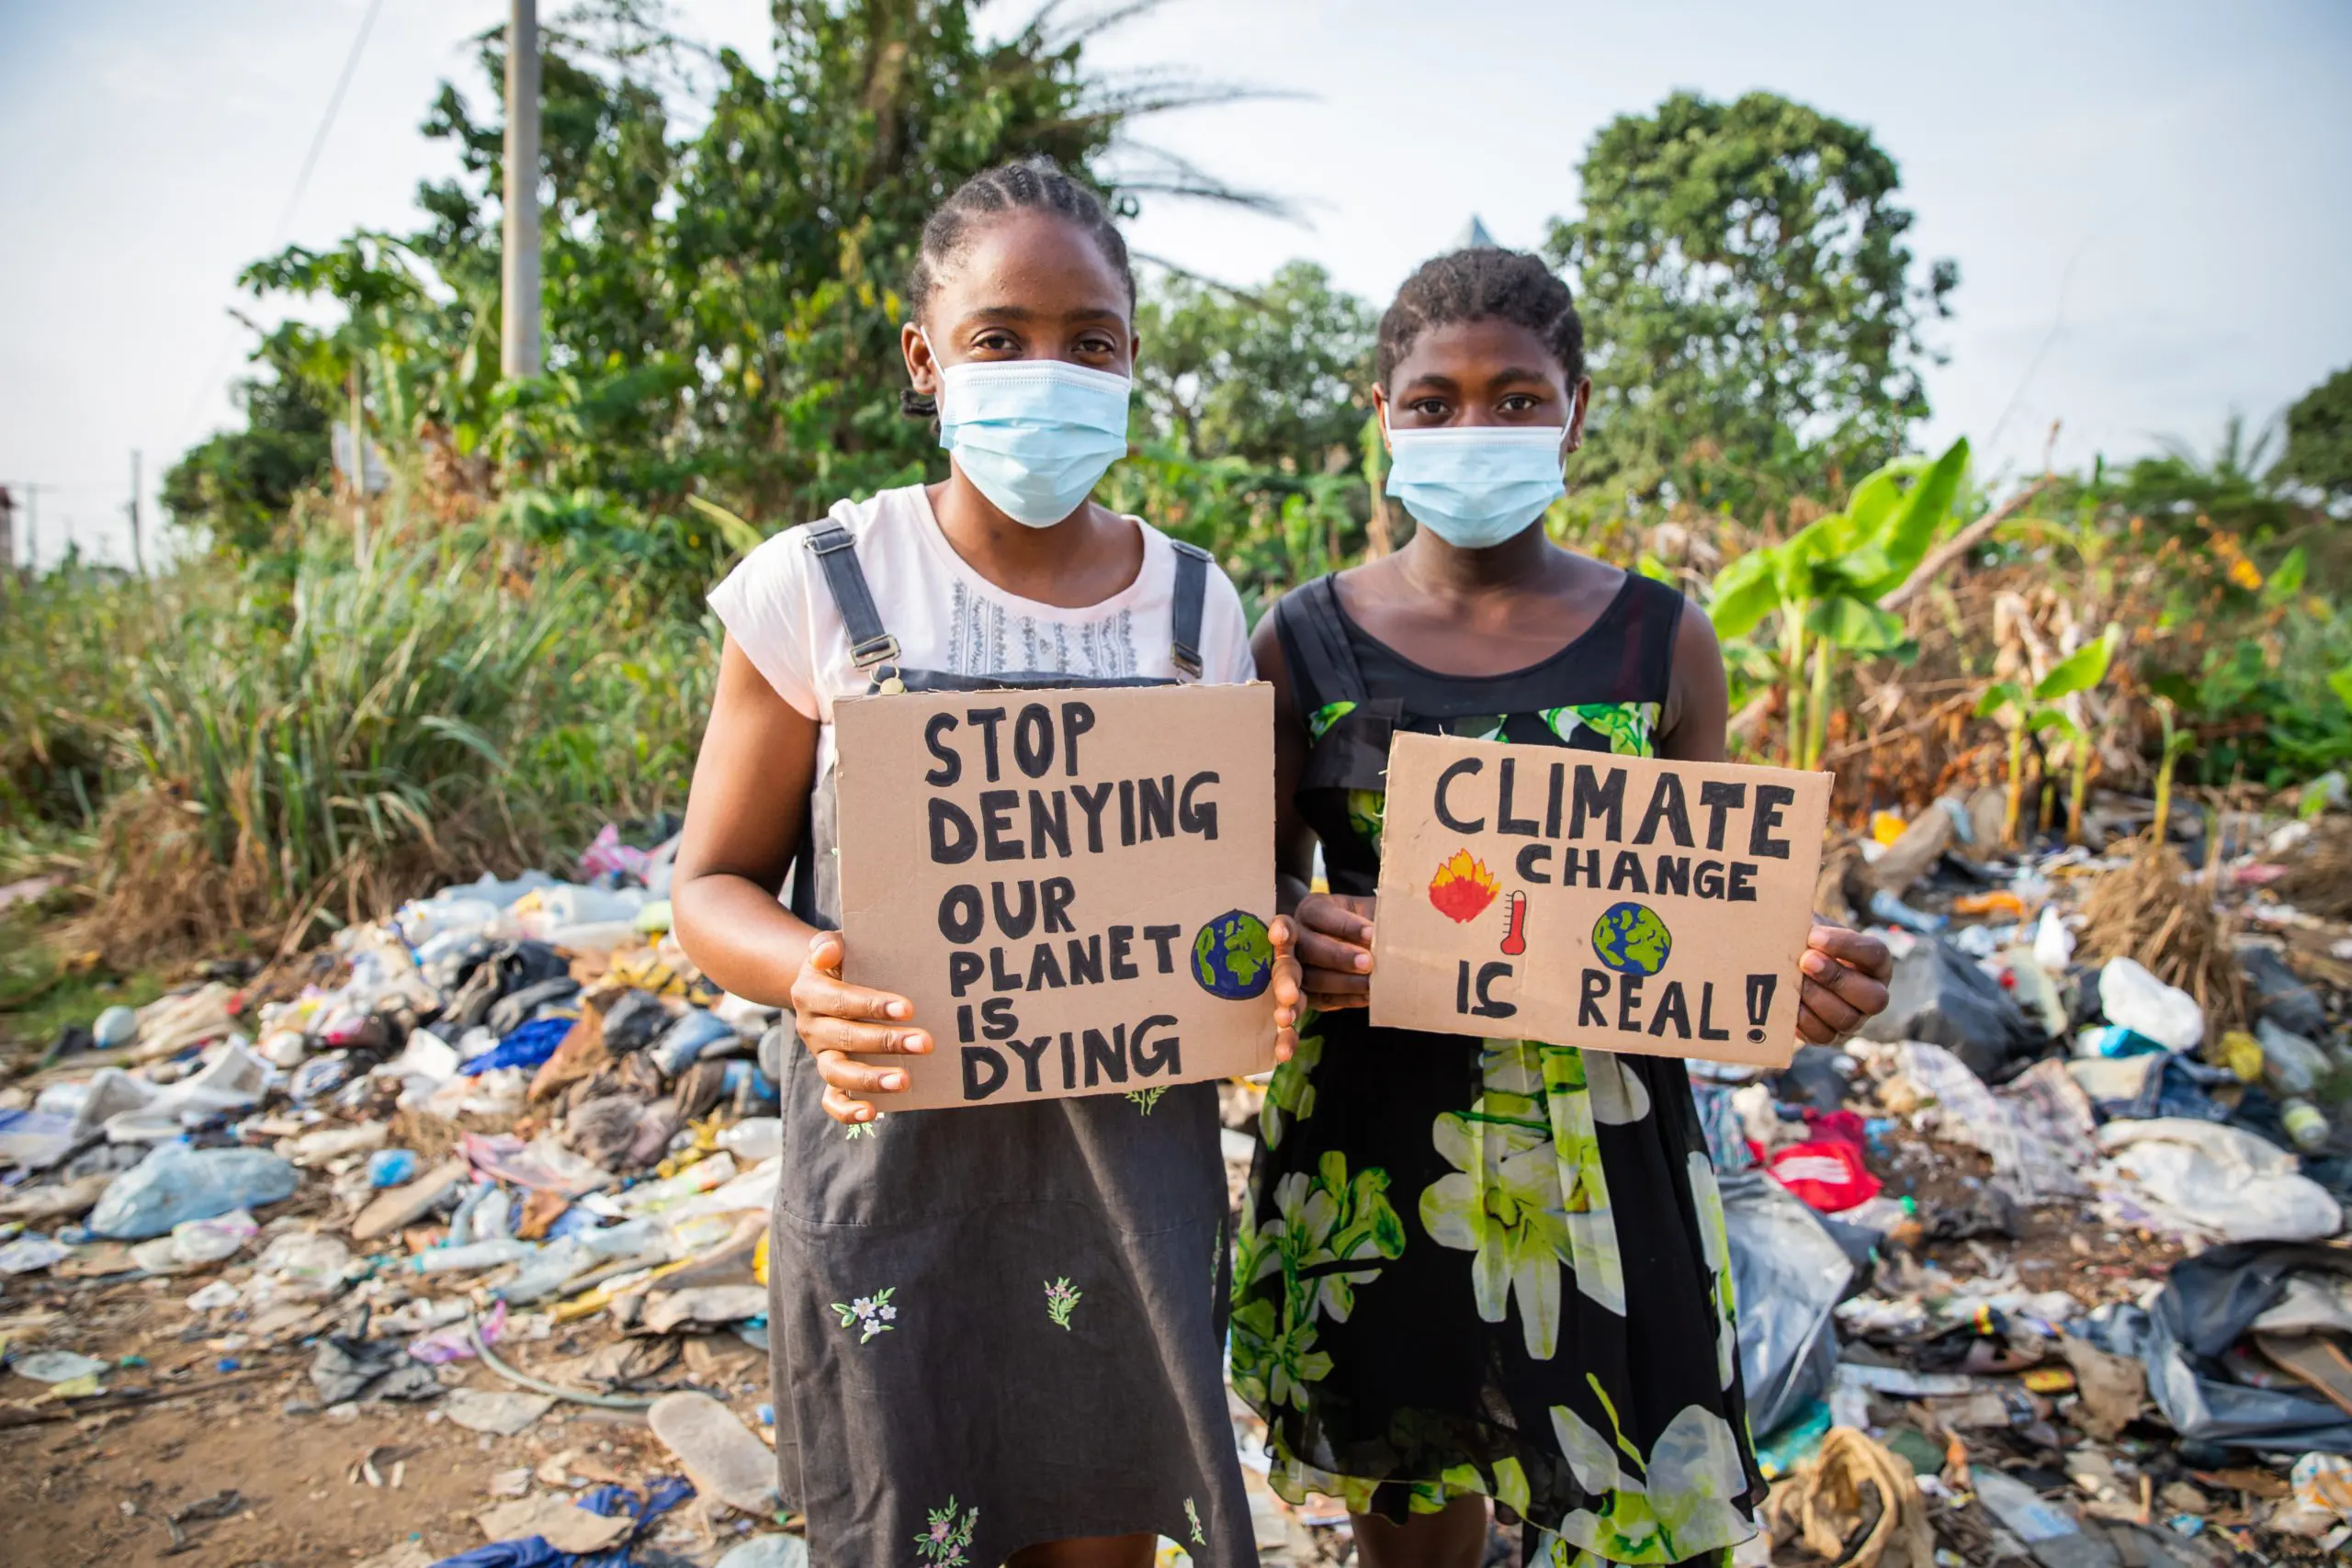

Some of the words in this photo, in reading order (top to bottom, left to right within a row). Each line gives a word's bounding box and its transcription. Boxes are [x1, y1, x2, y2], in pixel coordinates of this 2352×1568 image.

[924, 702, 1096, 787] STOP
[927, 771, 1220, 864] DENYING
[1434, 757, 1796, 860] CLIMATE
[937, 876, 1076, 944] OUR
[1515, 843, 1759, 902] CHANGE
[949, 923, 1182, 998] PLANET
[956, 997, 1020, 1043] IS
[961, 1014, 1182, 1100] DYING
